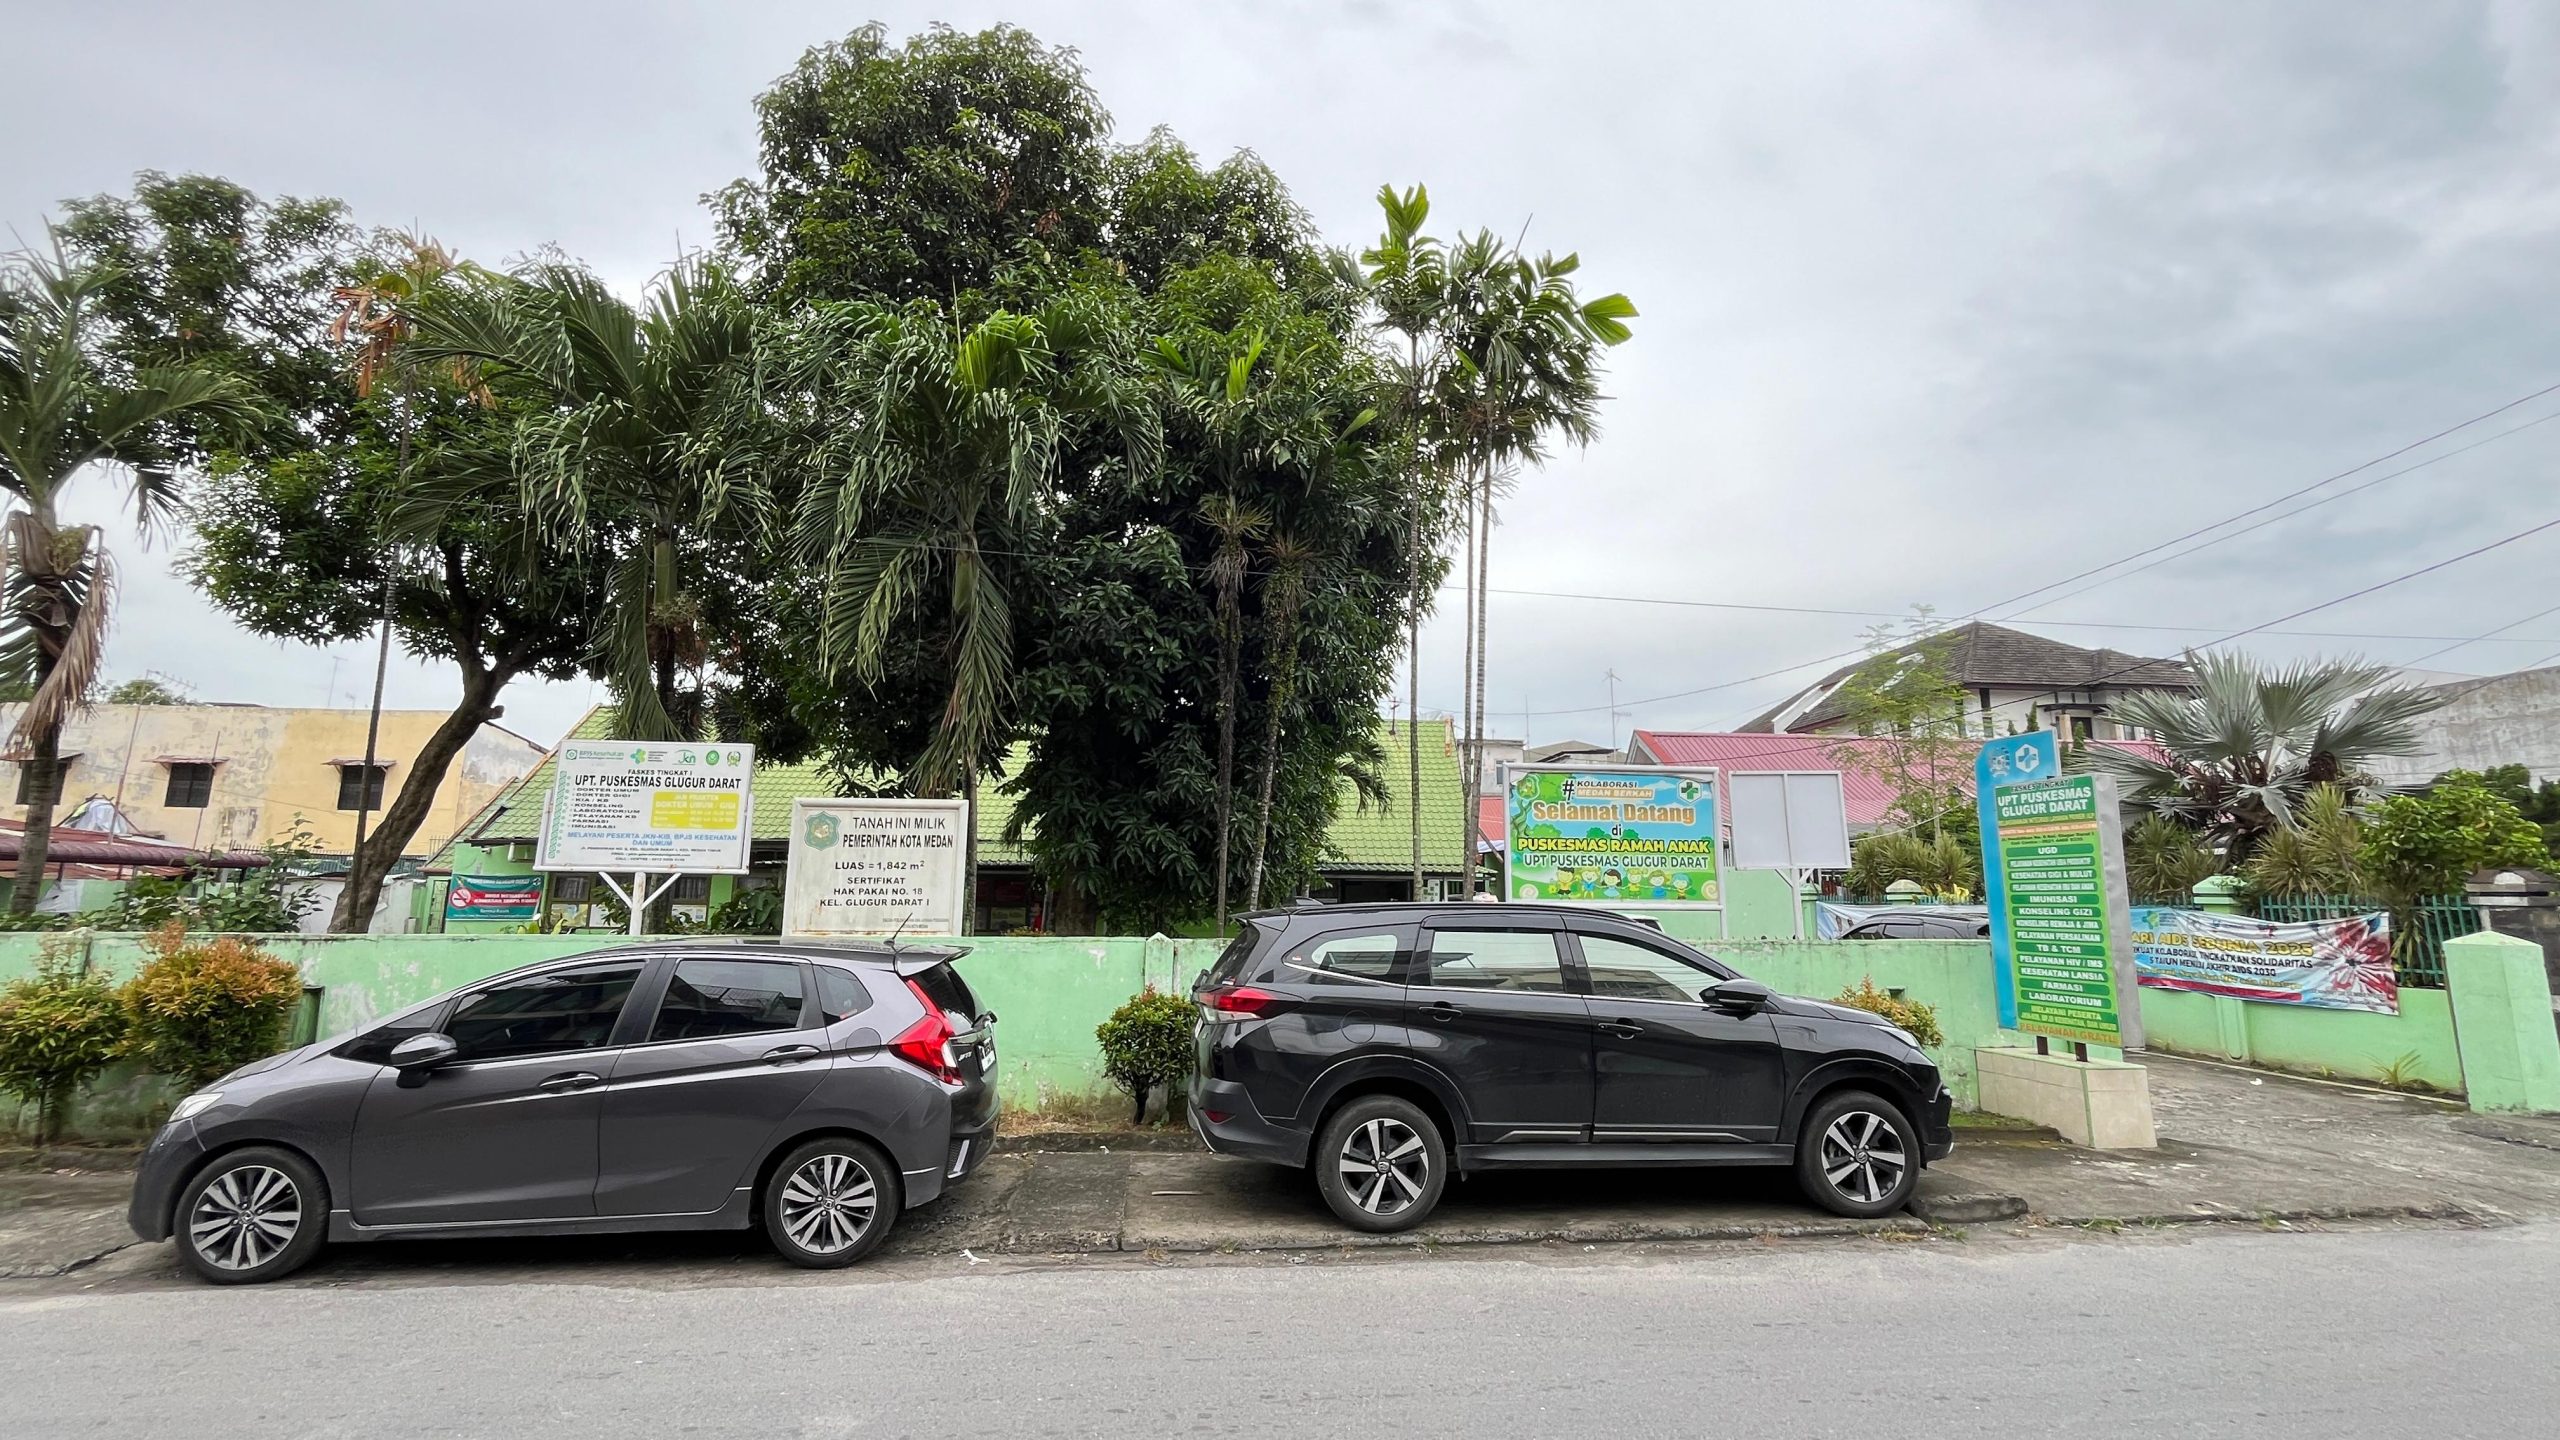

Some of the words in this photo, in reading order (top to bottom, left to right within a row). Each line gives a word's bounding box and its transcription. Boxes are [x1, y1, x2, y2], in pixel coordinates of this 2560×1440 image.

[575, 775, 596, 786] UPT.
[600, 775, 662, 788] PUSKESMAS
[665, 776, 705, 788] GLUGUR
[708, 778, 741, 789] DARAT
[1997, 795, 2018, 806] UPT
[2021, 787, 2091, 803] PUSKESMAS
[1533, 803, 1619, 820] Selamat
[1624, 804, 1695, 824] Datang
[2002, 804, 2047, 817] GLUGUR
[2049, 799, 2088, 812] DARAT
[853, 818, 892, 829] TANAH
[895, 818, 910, 829] INI
[914, 818, 945, 829] MILIK
[1612, 824, 1622, 836] di
[843, 834, 896, 848] PEMERINTAH
[900, 835, 922, 848] KOTA
[924, 835, 953, 848] MEDAN
[1518, 838, 1607, 852] PUSKESMAS
[1610, 839, 1664, 853] RAMAH
[1667, 840, 1709, 853] ANAK
[835, 862, 864, 870] LUAS
[877, 862, 907, 871] 1,842
[1524, 855, 1547, 865] UPT
[1550, 855, 1619, 867] PUSKESMAS
[1623, 856, 1667, 867] GLUGUR
[1670, 856, 1708, 868] DARAT
[2073, 908, 2092, 916] GIZI
[2056, 933, 2100, 941] PERSALINAN
[2036, 944, 2049, 952] TB
[2132, 931, 2155, 944] ARI
[2158, 932, 2189, 947] AIDS
[2264, 941, 2314, 957] 2025
[2020, 955, 2064, 965] PELAYANAN
[2251, 956, 2313, 968] SOLIDARITAS
[2021, 968, 2069, 978] KESEHATAN
[2071, 971, 2104, 981] LANSIA
[2232, 965, 2252, 975] AIDS
[2254, 968, 2276, 976] 2030
[2042, 981, 2083, 992] FARMASI
[2029, 992, 2102, 1006] LABORATORIUM
